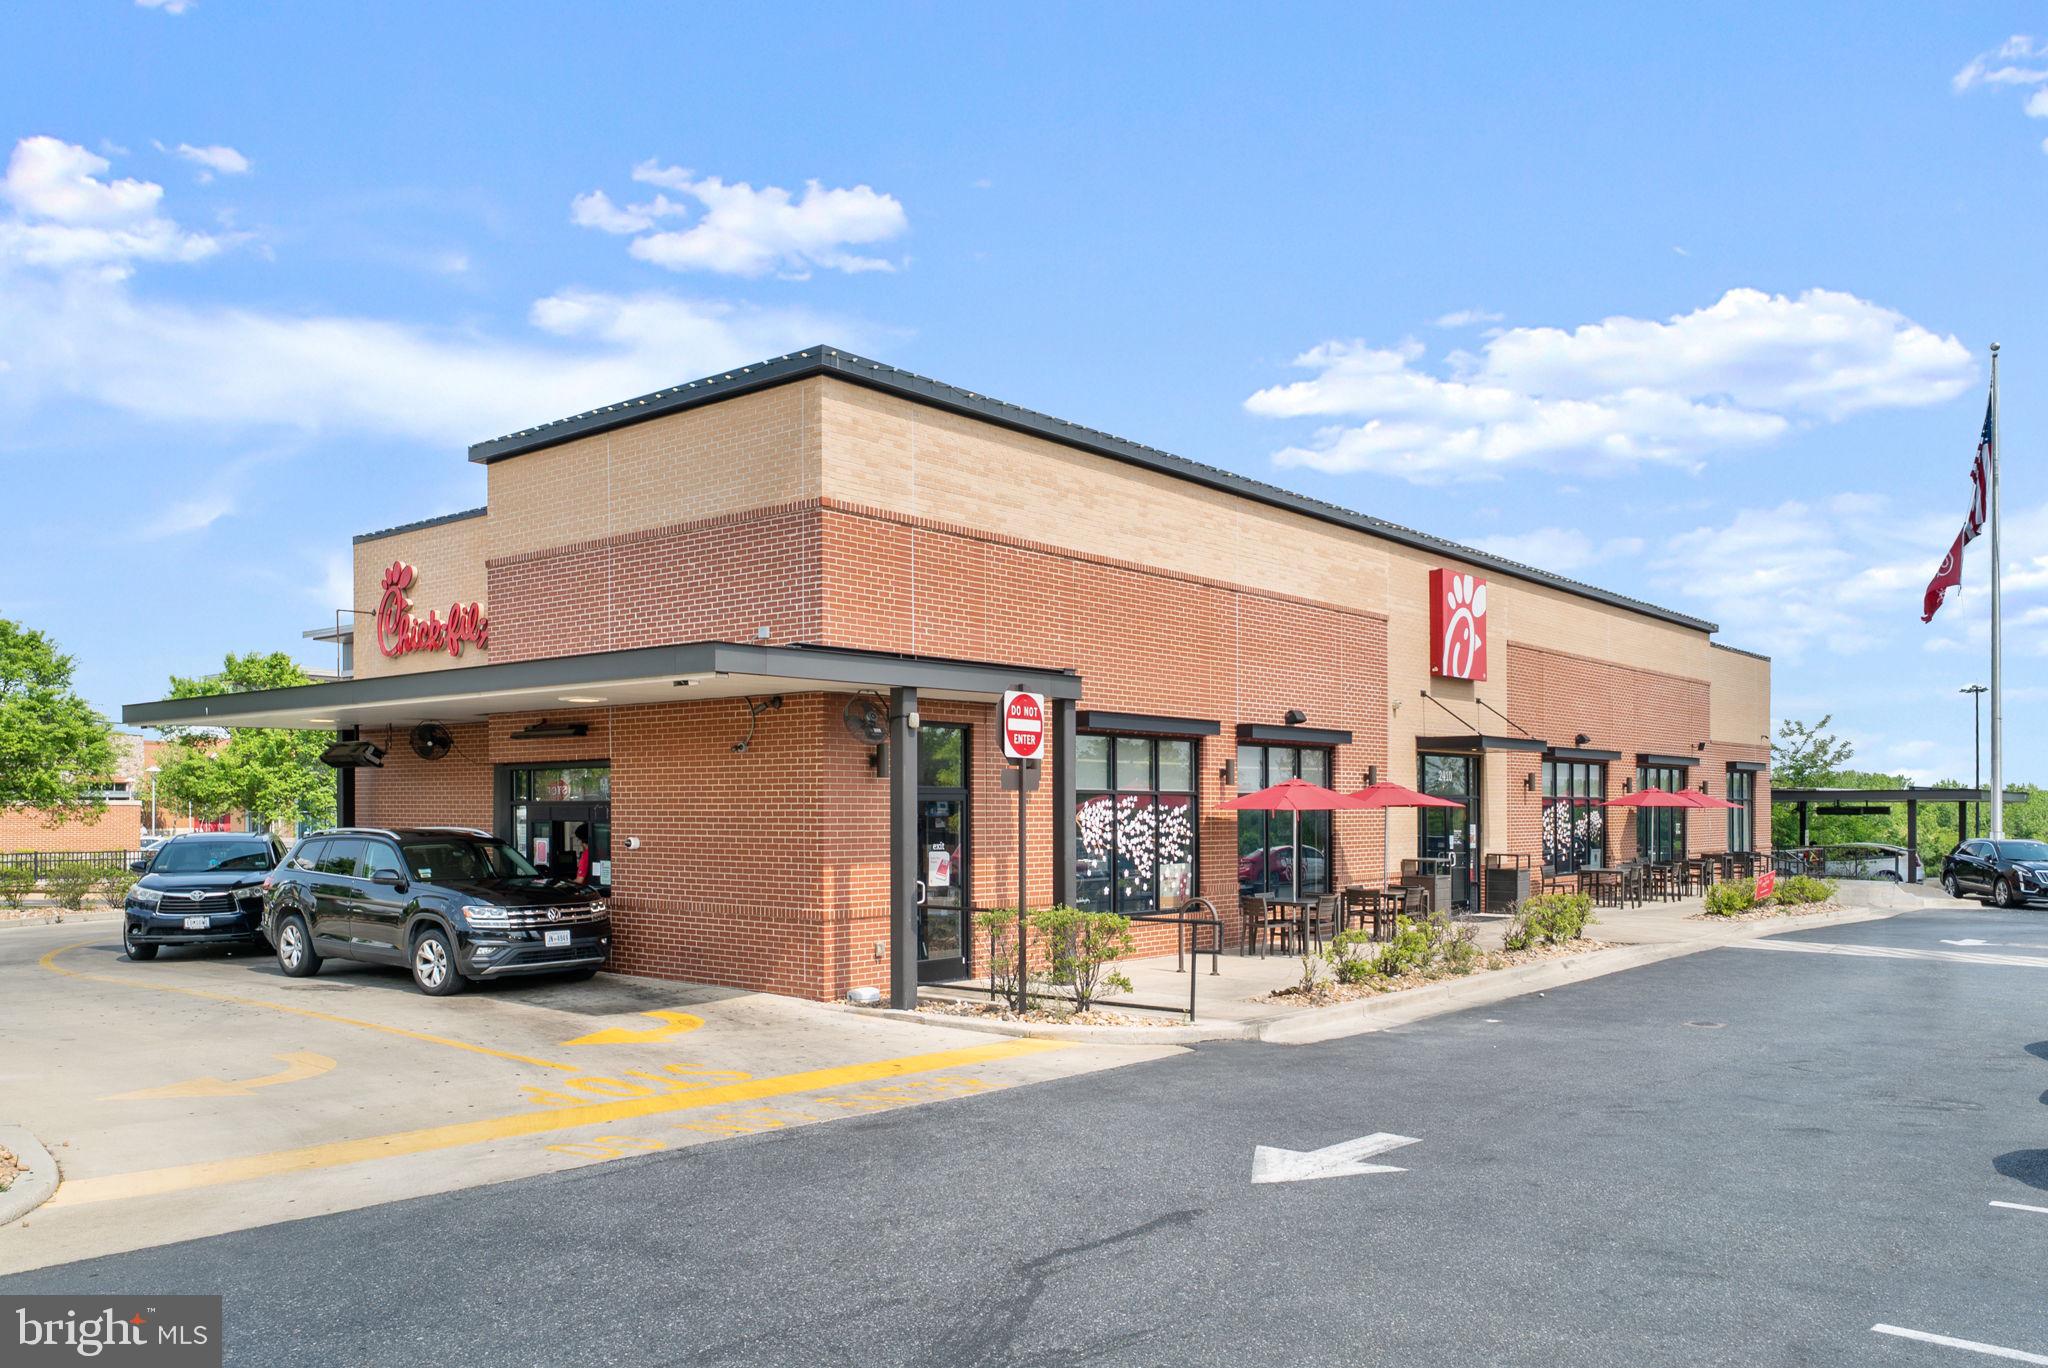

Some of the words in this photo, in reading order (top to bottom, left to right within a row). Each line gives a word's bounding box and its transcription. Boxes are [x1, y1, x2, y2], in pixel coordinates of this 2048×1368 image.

[1011, 705, 1021, 716] DO
[1024, 706, 1038, 717] NOT
[1014, 733, 1036, 745] ENTER
[1438, 772, 1453, 782] 2410
[932, 842, 945, 850] exit
[520, 1063, 752, 1106] STOP
[544, 1135, 667, 1160] DO
